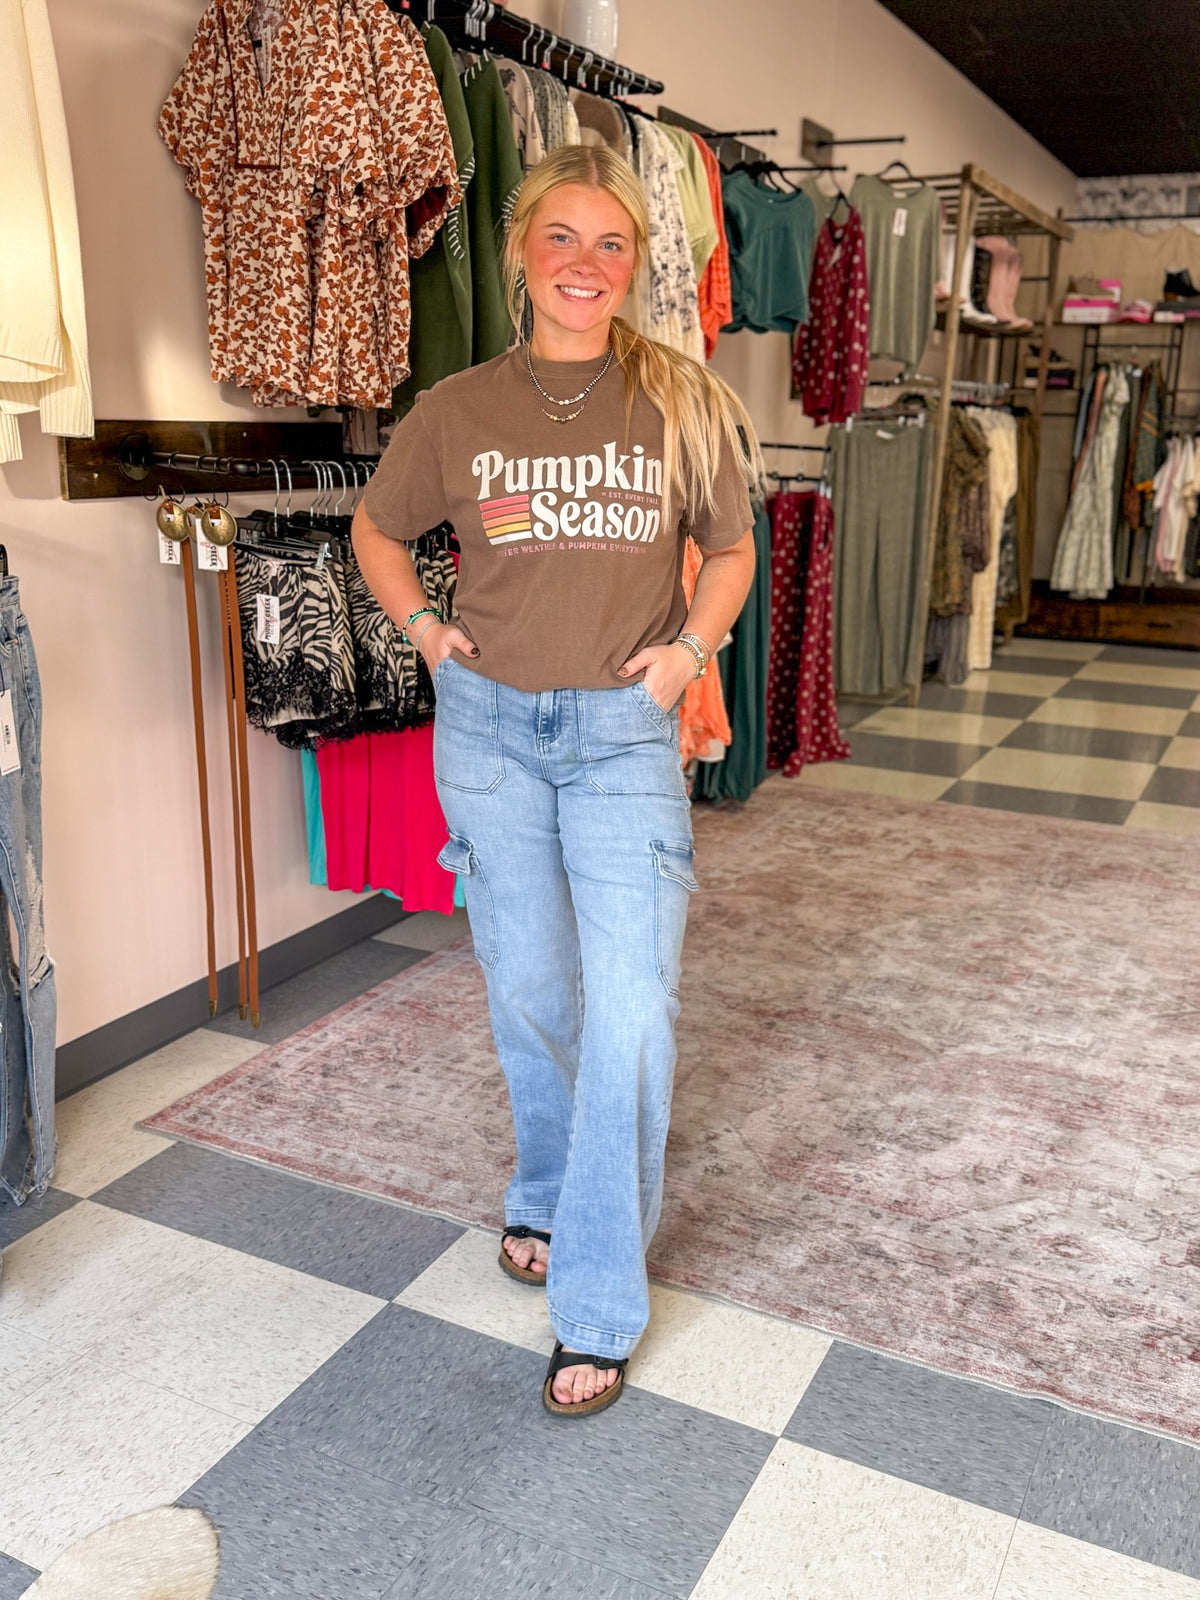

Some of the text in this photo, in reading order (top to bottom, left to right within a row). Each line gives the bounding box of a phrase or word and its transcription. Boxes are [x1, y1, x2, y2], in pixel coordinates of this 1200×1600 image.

[472, 441, 663, 501] Pumpkin
[608, 491, 623, 499] EST.
[625, 493, 645, 503] EVERY
[531, 491, 661, 543] Season
[558, 542, 565, 550] &
[568, 541, 607, 551] PUMPKIN
